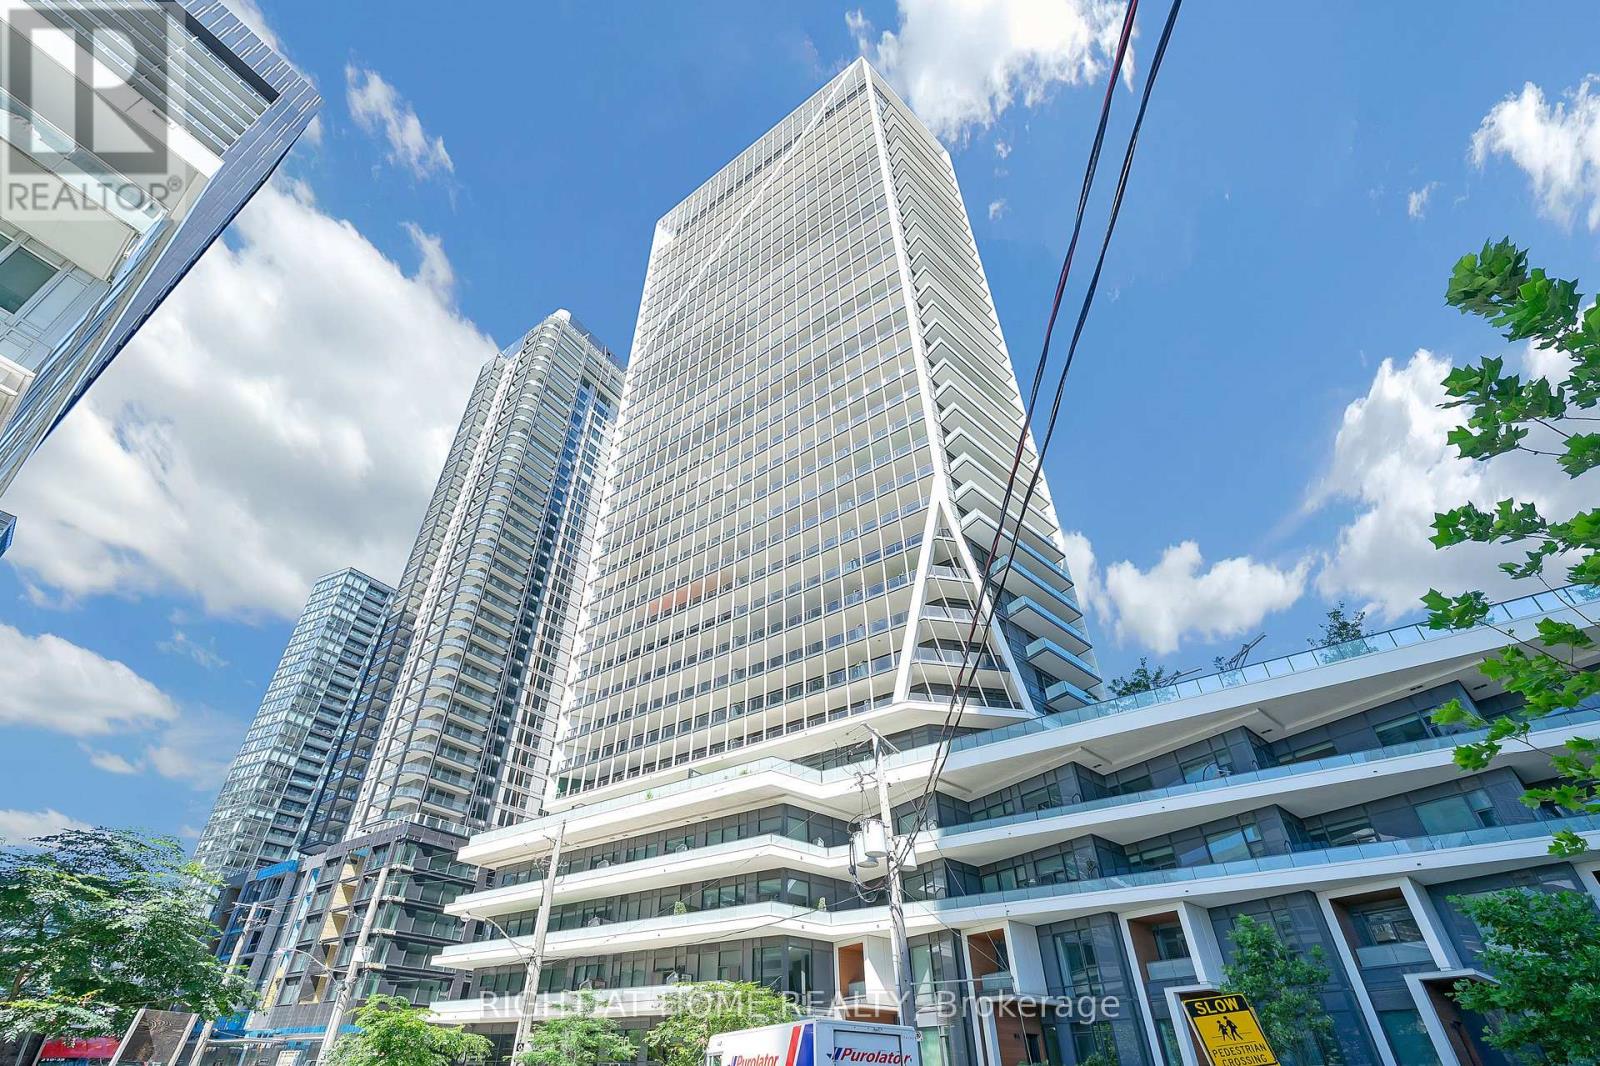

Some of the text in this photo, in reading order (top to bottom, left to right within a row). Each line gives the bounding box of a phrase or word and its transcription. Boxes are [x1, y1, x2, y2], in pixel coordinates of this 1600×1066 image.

[1194, 996, 1240, 1015] SLOW
[840, 1047, 912, 1064] Purolator
[1211, 1043, 1267, 1058] PEDESTRIAN
[736, 1053, 780, 1066] Purolator
[1222, 1053, 1268, 1066] CROSSING
